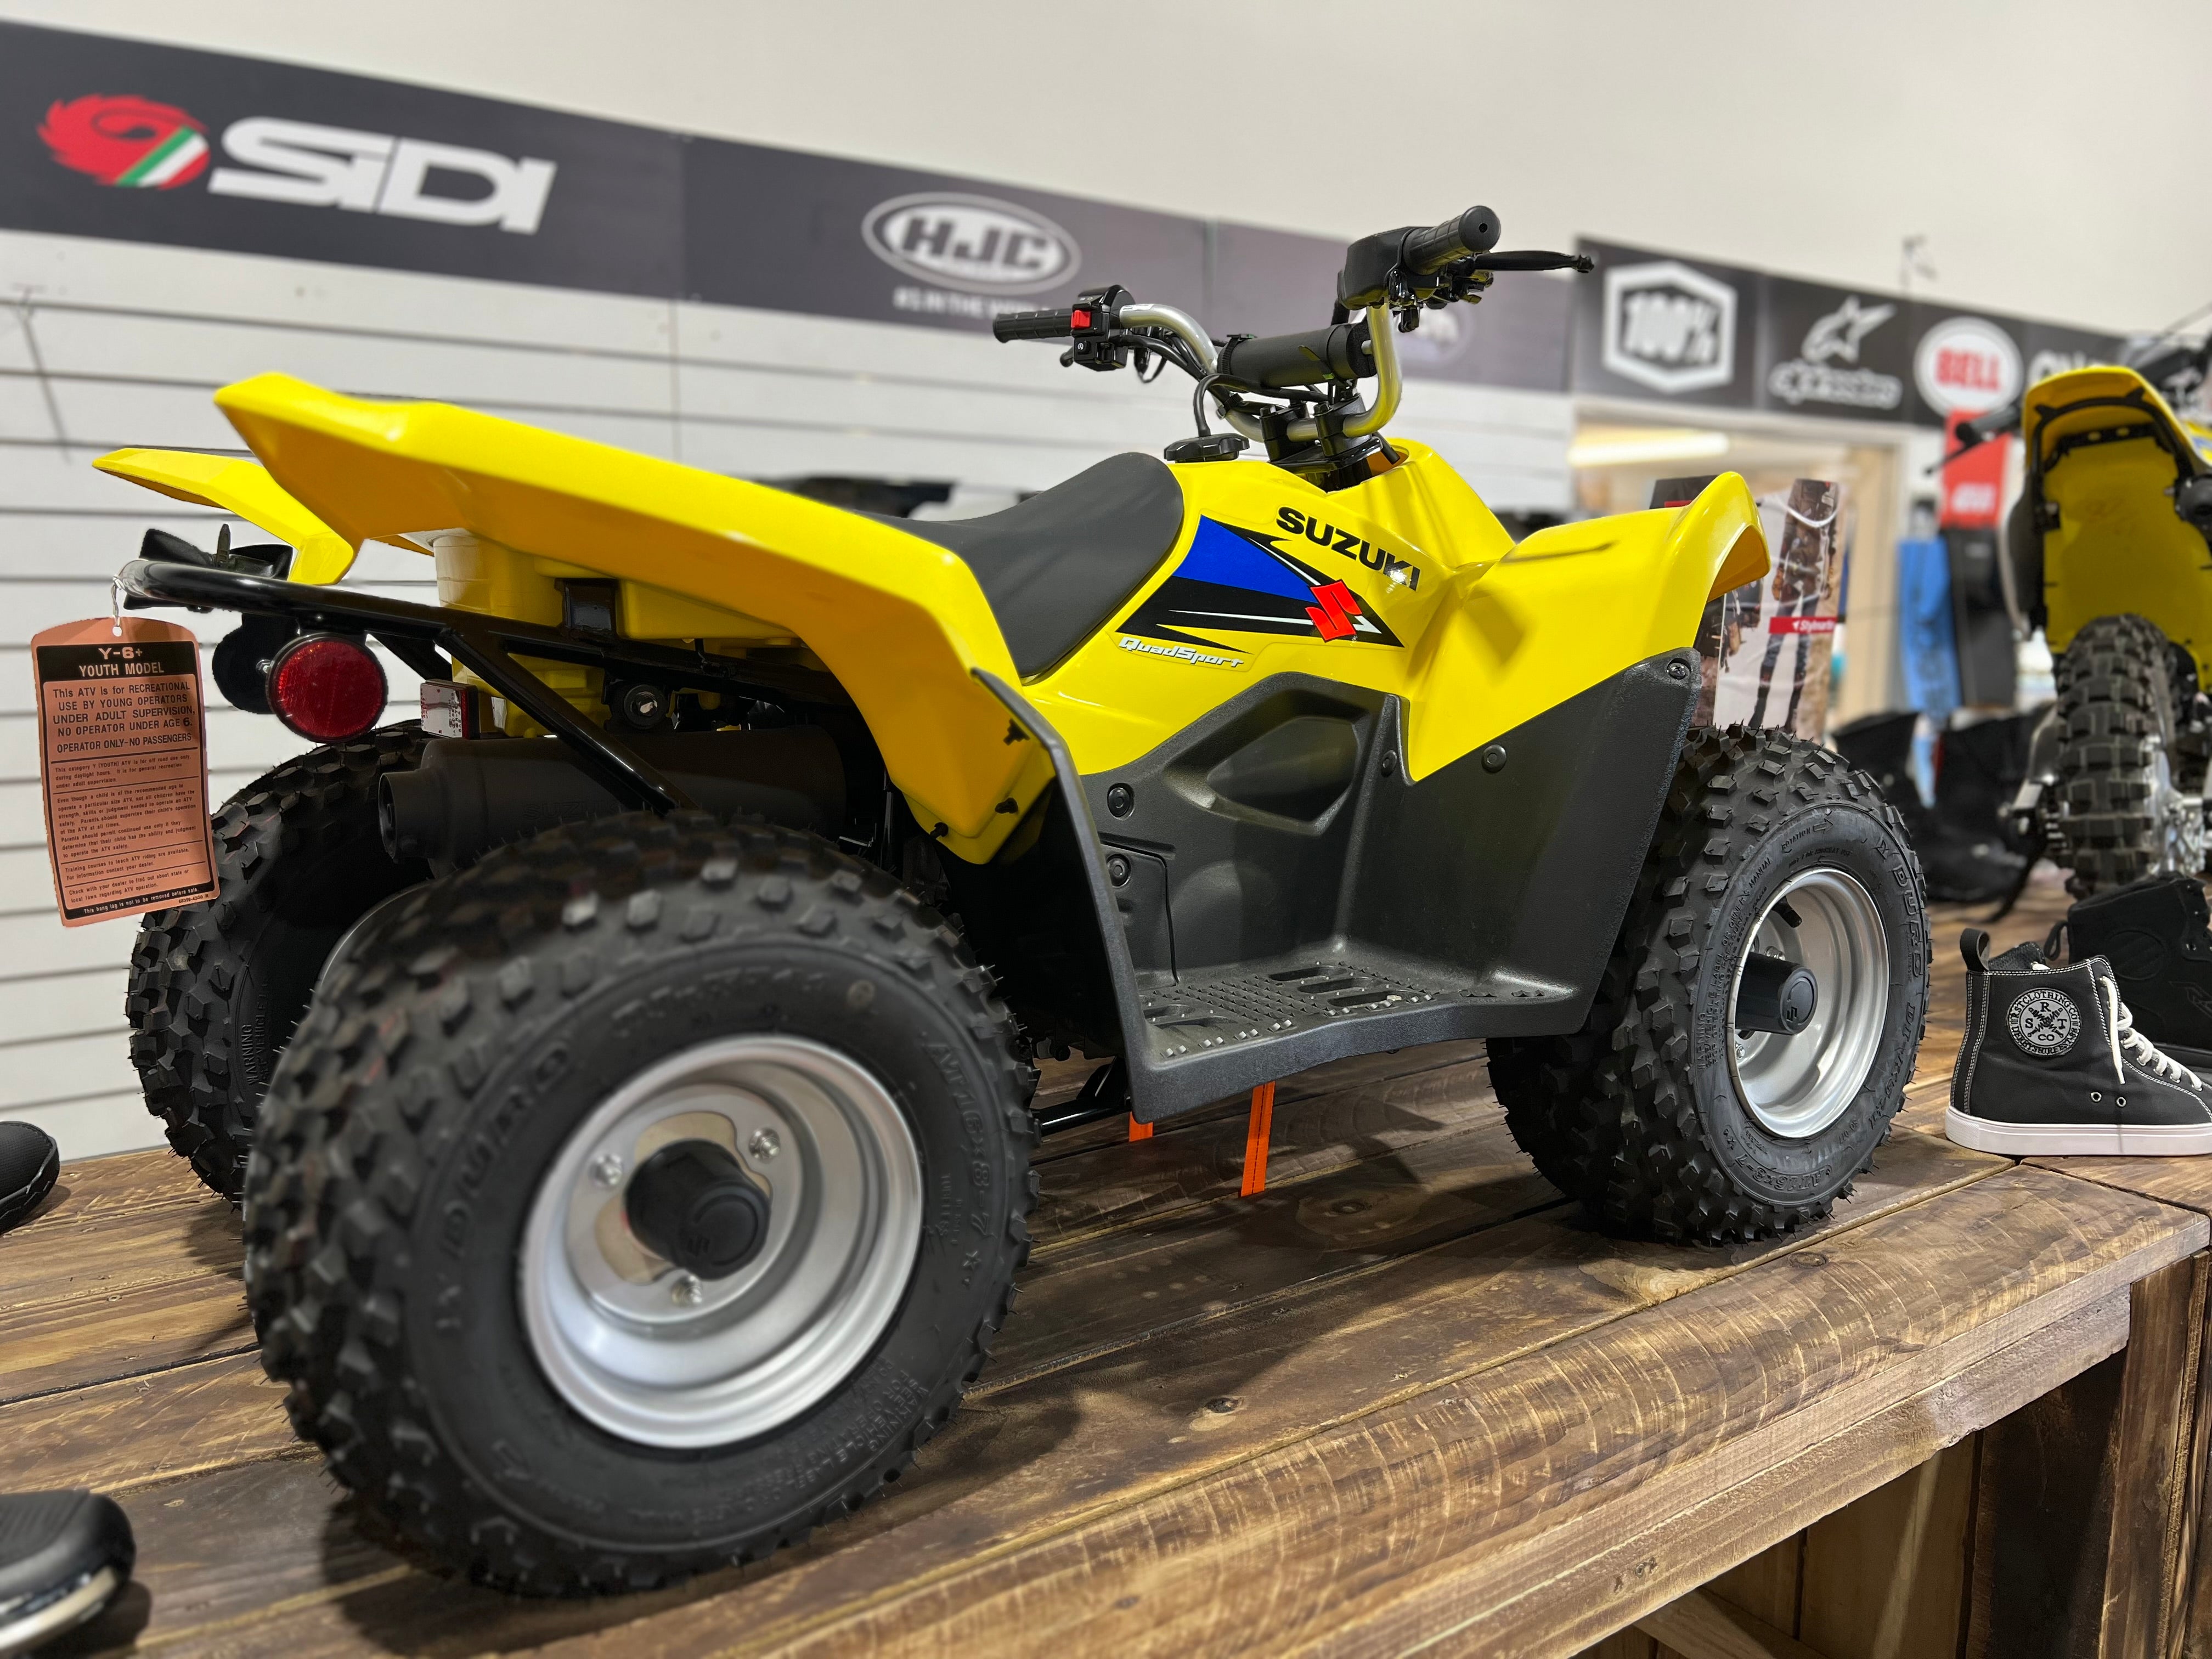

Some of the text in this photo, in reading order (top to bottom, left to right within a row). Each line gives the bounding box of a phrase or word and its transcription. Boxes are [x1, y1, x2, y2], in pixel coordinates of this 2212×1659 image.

[208, 116, 557, 235] SIDI
[901, 216, 1047, 269] HJC
[1625, 292, 1717, 362] 100%
[1936, 347, 2000, 392] BELL
[1276, 506, 1421, 591] SUZUKI
[98, 646, 143, 660] Y-6+
[1119, 636, 1244, 668] QuadSport
[78, 662, 165, 677] YOUTH MODEL
[52, 681, 190, 698] This ATV is for RECREATIONAL
[58, 693, 187, 712] USE BY YOUNG OPERATORS
[53, 705, 195, 725] UNDER ADULT SUPERVISION,
[58, 716, 193, 737] NO OPERATOR UNDER AGE 6.
[57, 740, 101, 753] OPERATOR
[142, 732, 191, 745] PASSENGERS
[134, 785, 166, 793] recommended
[84, 800, 109, 809] particular
[106, 805, 128, 814] judgment
[175, 825, 196, 834] judgment
[76, 870, 104, 879] information
[99, 889, 122, 898] regarding
[150, 892, 170, 901] removed
